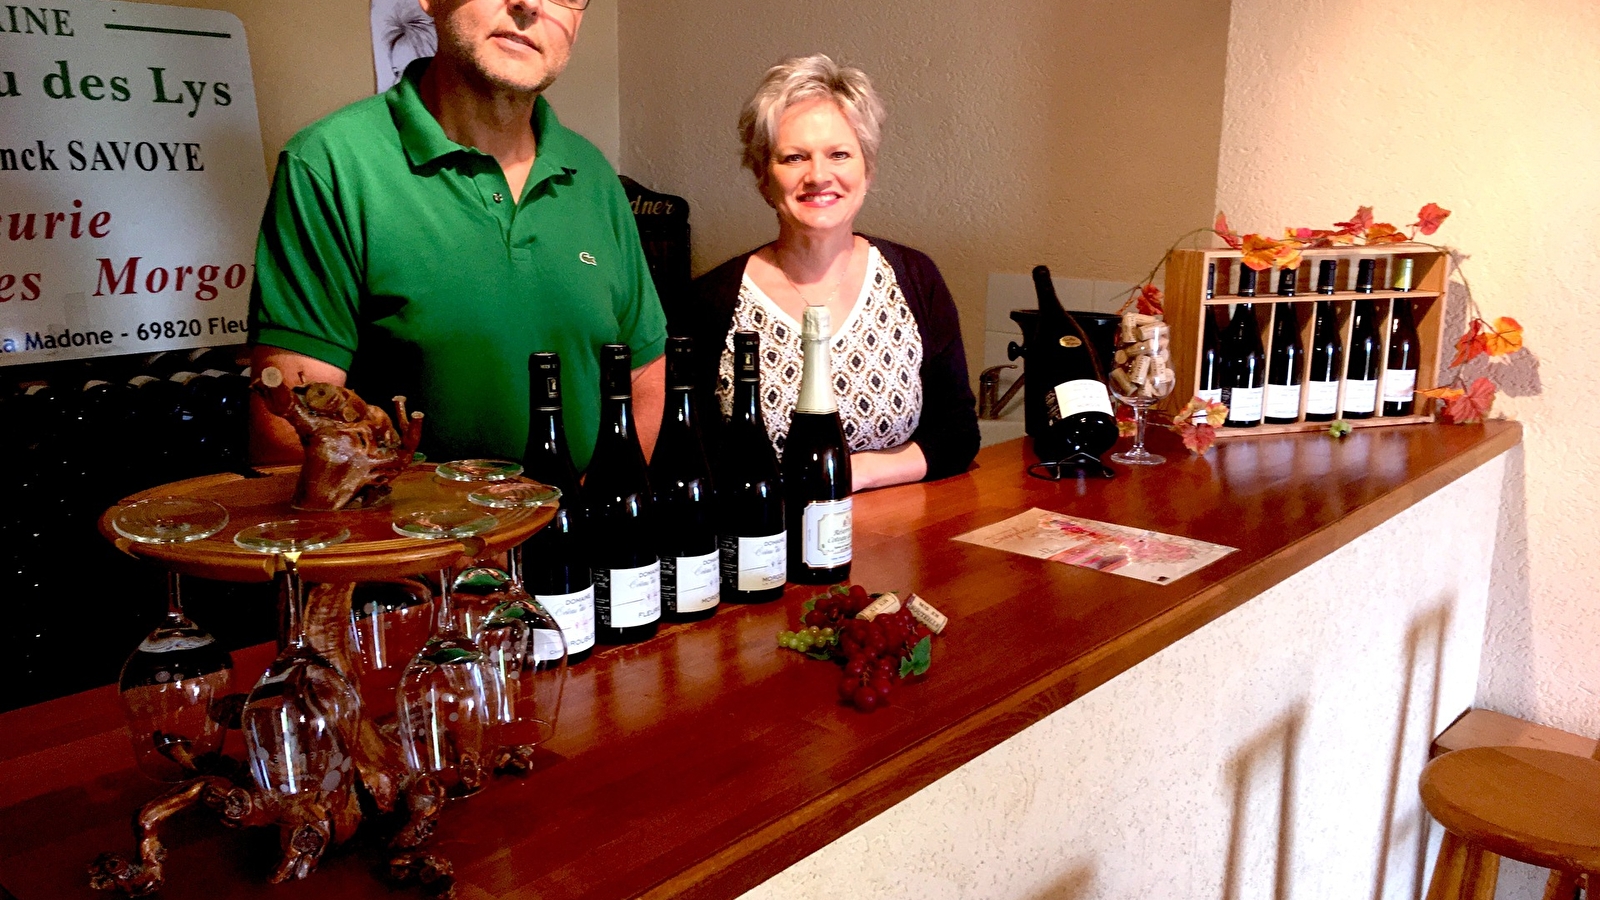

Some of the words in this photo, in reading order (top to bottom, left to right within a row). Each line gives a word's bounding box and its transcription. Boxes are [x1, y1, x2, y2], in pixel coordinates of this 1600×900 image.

[43, 60, 132, 102] des
[147, 67, 232, 118] Lys
[0, 140, 60, 172] nck
[67, 140, 205, 172] SAVOYE
[0, 199, 112, 241] urie
[92, 256, 255, 302] Morgo
[0, 338, 16, 353] a
[25, 328, 114, 351] Madone
[137, 319, 202, 342] 69820
